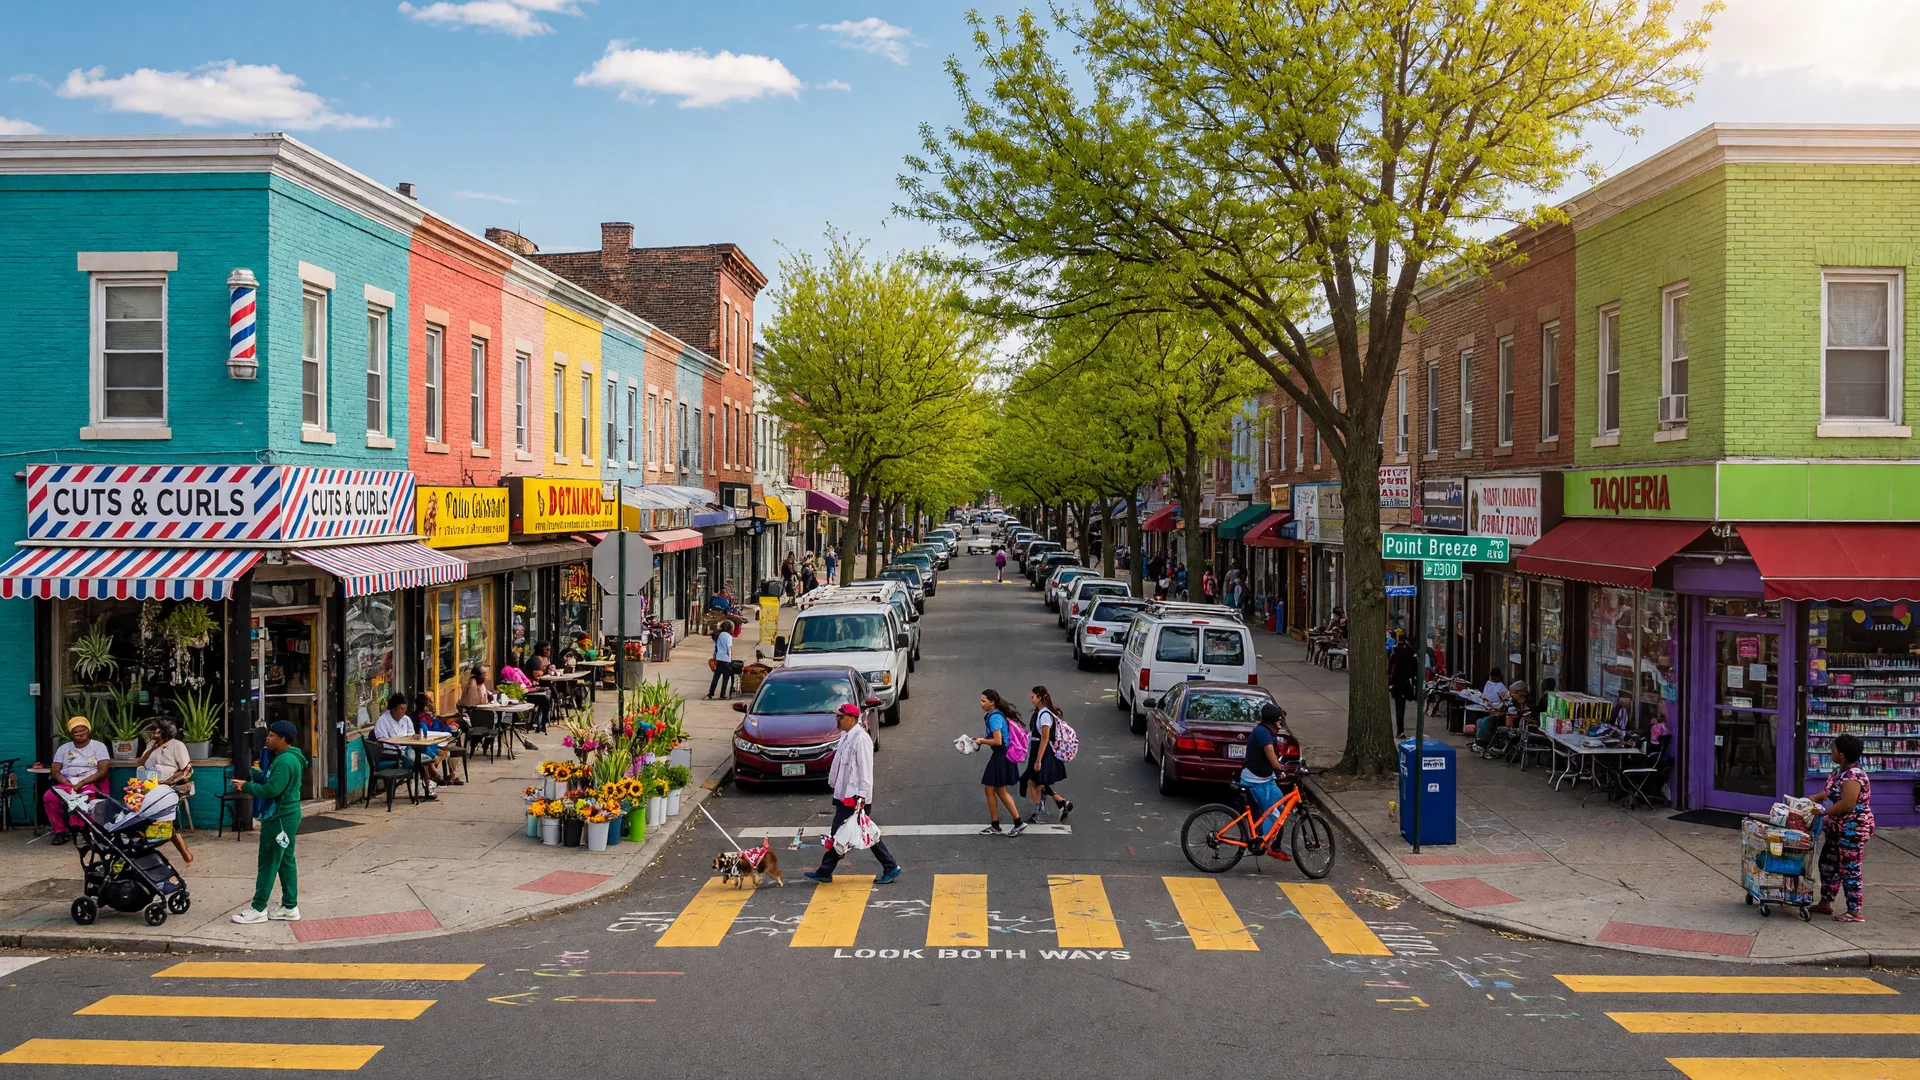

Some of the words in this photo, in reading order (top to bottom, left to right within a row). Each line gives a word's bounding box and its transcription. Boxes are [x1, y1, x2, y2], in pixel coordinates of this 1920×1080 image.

[53, 488, 122, 516] CUTS
[131, 488, 148, 516] &
[157, 488, 245, 517] CURLS
[311, 489, 342, 516] CUTS
[344, 490, 352, 516] &
[354, 490, 388, 516] CURLS
[1590, 474, 1671, 515] TAQUERIA
[1386, 537, 1422, 555] Point
[1429, 538, 1478, 557] Breeze
[833, 948, 925, 959] LOOK
[938, 949, 1027, 959] BOTH
[1038, 949, 1132, 960] WAYS
